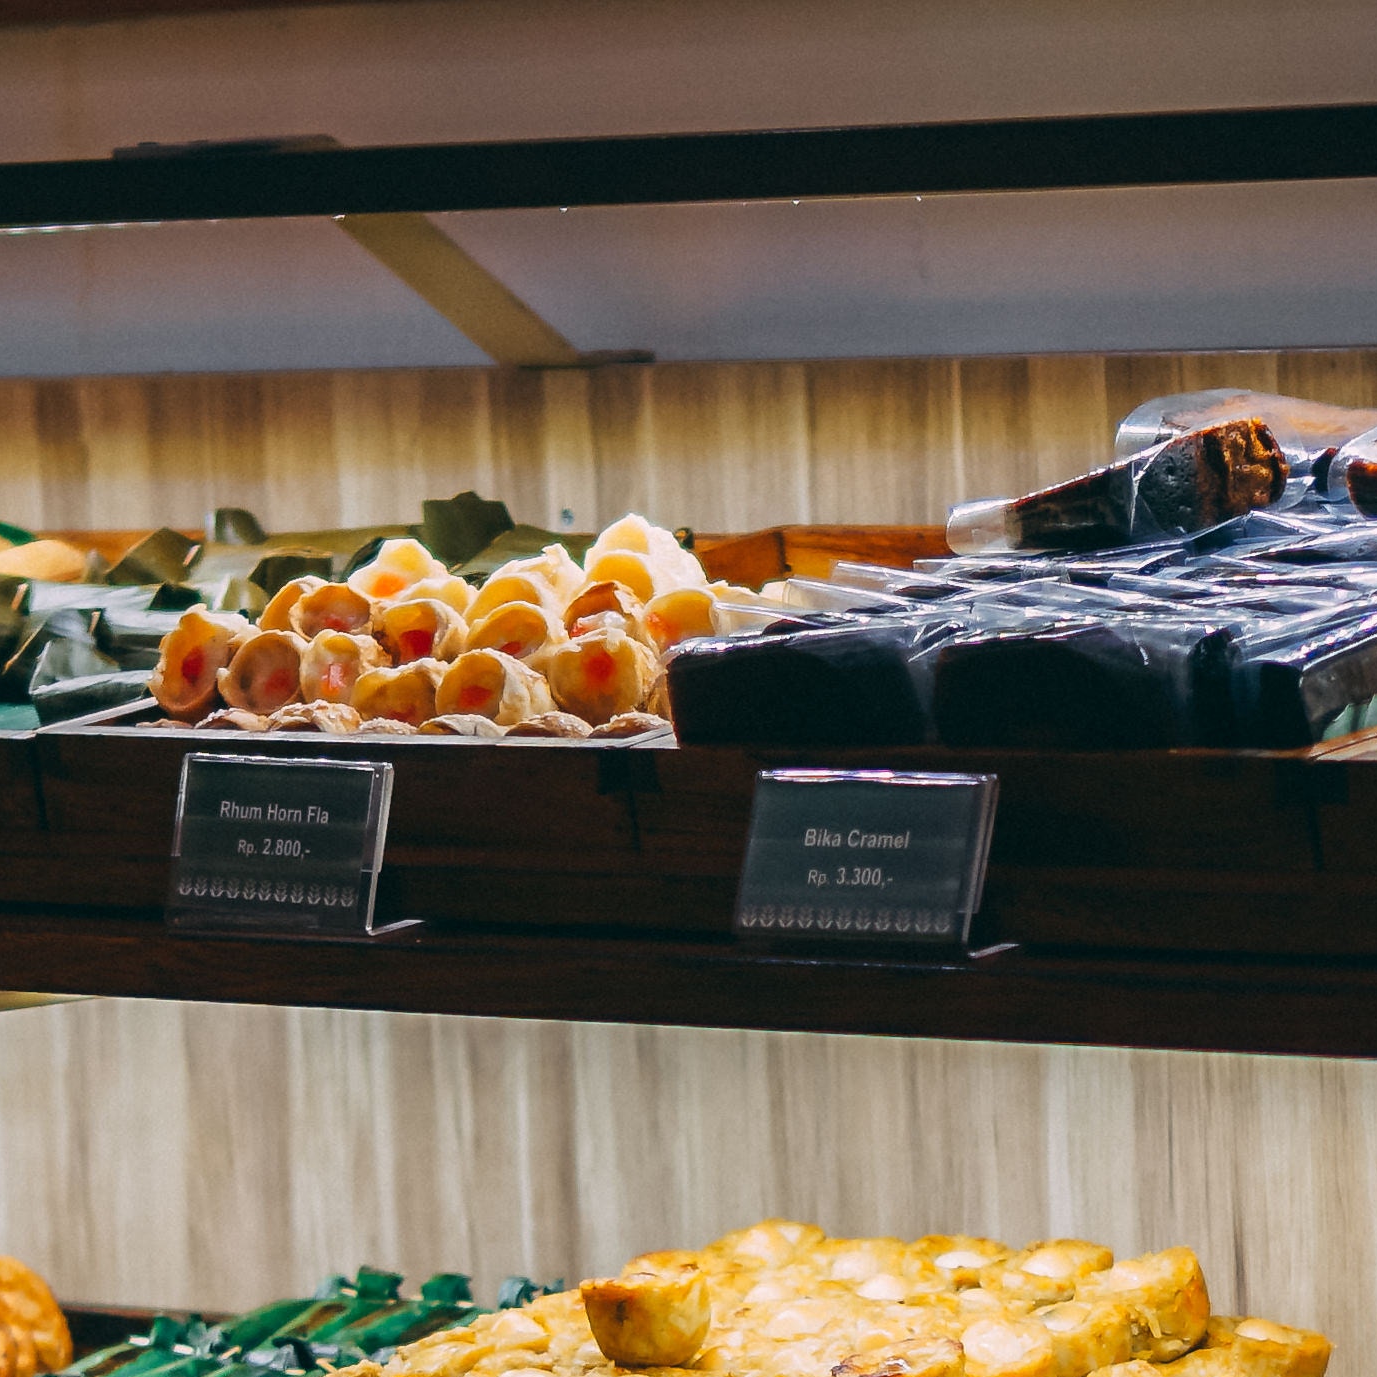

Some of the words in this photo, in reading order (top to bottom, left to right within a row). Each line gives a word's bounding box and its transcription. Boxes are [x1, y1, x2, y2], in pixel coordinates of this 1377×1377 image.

[219, 800, 262, 820] Rhum
[267, 803, 302, 822] Horn
[307, 805, 330, 825] Fla
[237, 839, 258, 858] Rp.
[262, 837, 311, 859] 2.800,-
[803, 828, 842, 848] Bika
[847, 829, 910, 849] Cramel
[807, 868, 831, 887] Rp.
[836, 867, 894, 889] 3.300,-
